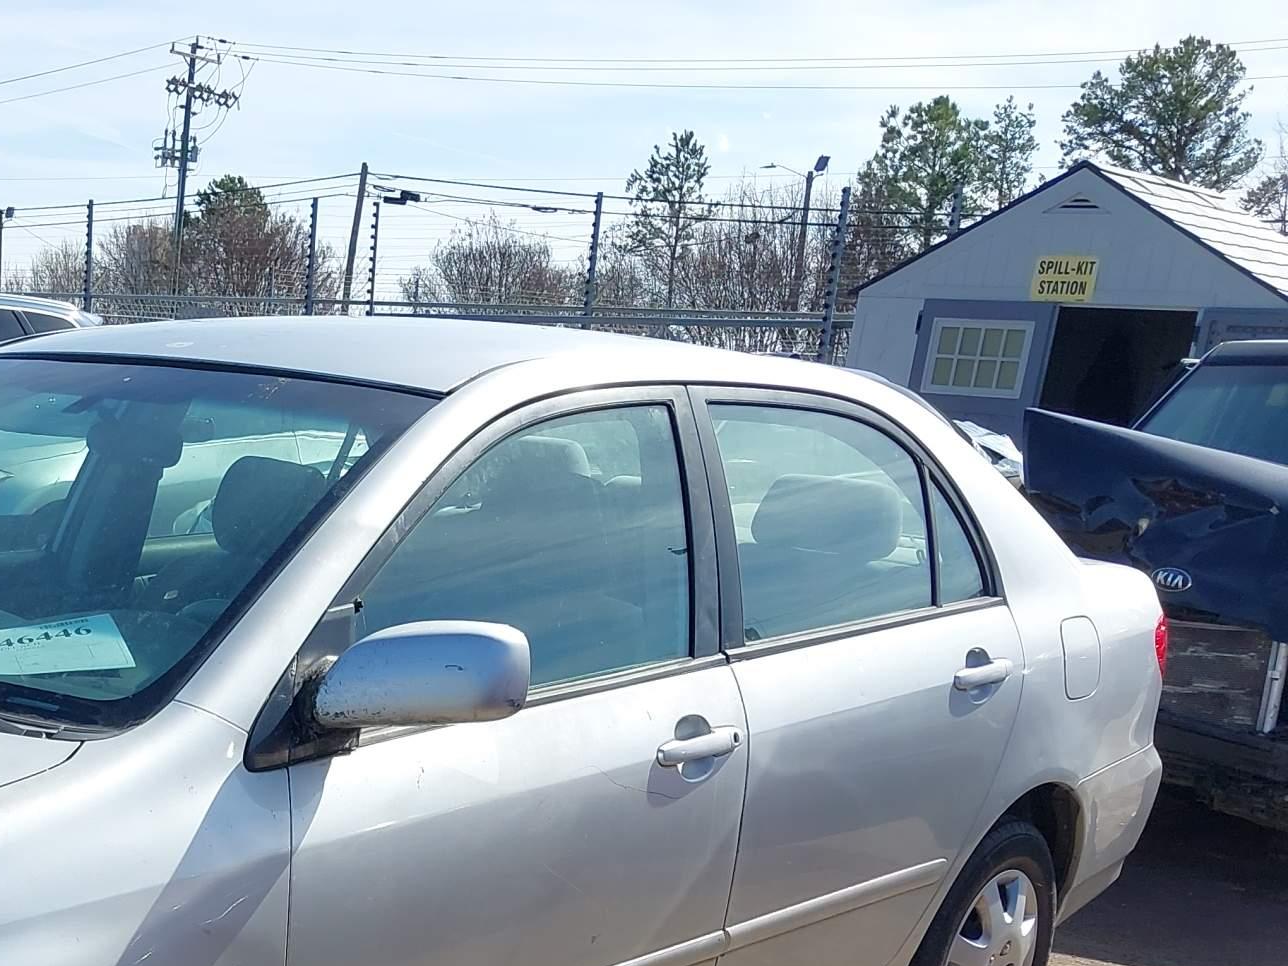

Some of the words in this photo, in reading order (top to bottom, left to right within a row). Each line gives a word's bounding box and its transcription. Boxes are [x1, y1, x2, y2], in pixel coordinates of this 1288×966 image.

[1038, 260, 1096, 275] SPILL-KIT
[1038, 280, 1087, 295] STATION
[1156, 571, 1184, 589] KIA
